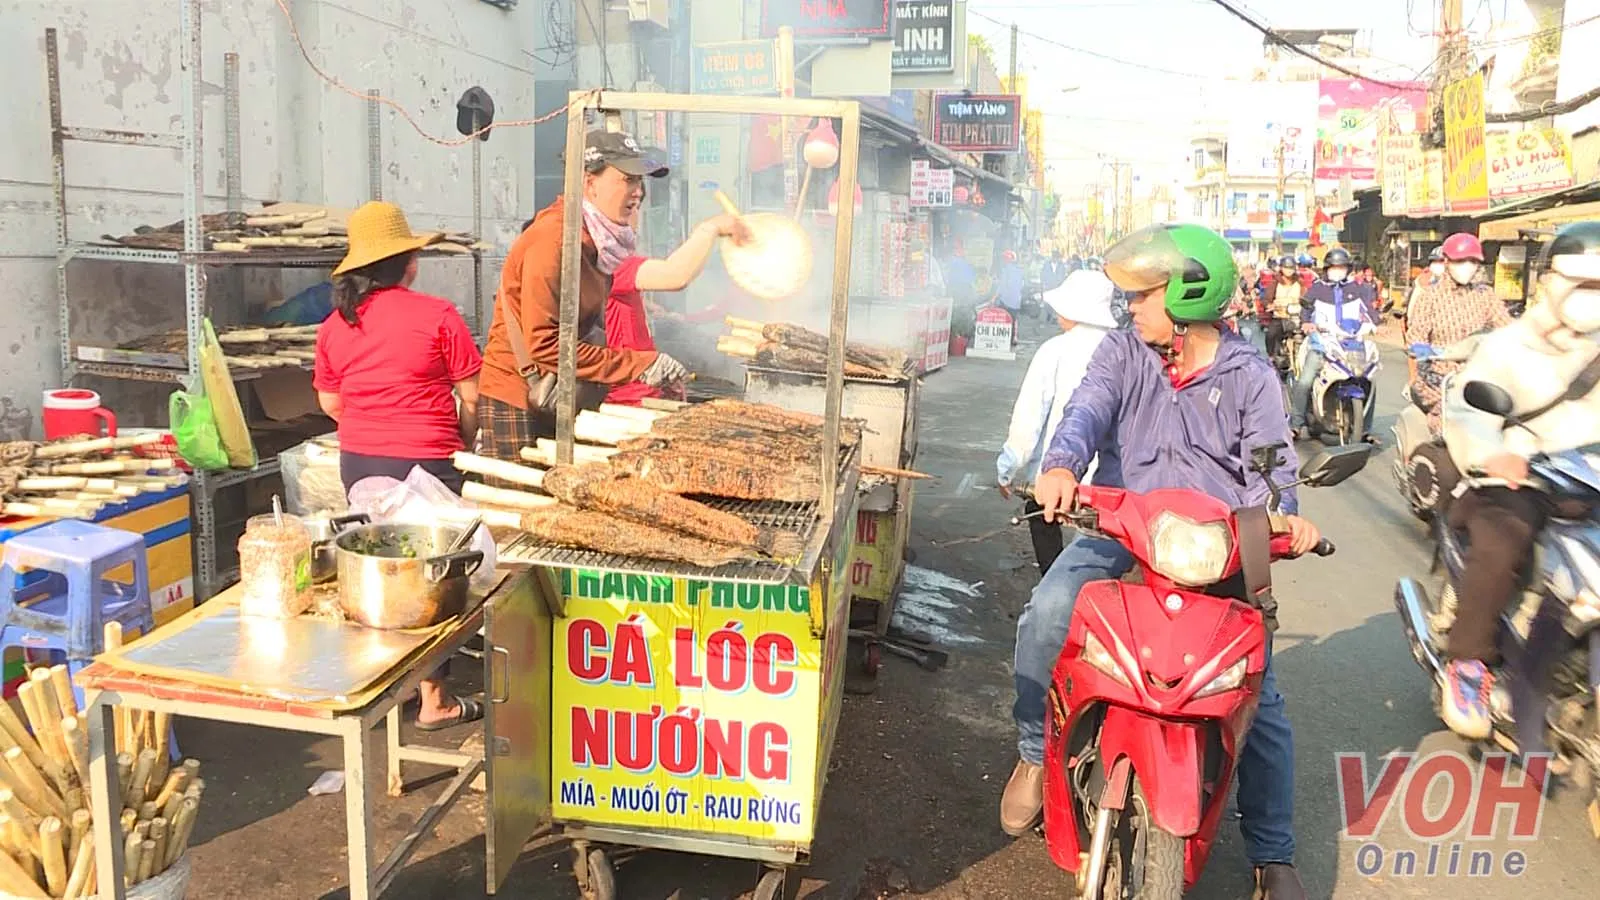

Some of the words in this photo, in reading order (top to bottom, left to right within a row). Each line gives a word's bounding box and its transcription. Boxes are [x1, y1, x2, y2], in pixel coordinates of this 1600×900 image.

[922, 3, 948, 18] KÍNH
[895, 28, 944, 51] INH
[567, 613, 654, 687] CÁ
[675, 620, 796, 695] LÓC
[571, 704, 790, 782] NƯỚNG
[561, 779, 595, 806] MÍA
[611, 783, 659, 812] MUỐI
[666, 787, 688, 814] ỚT
[705, 795, 741, 819] RAU
[748, 794, 801, 824] RỪNG
